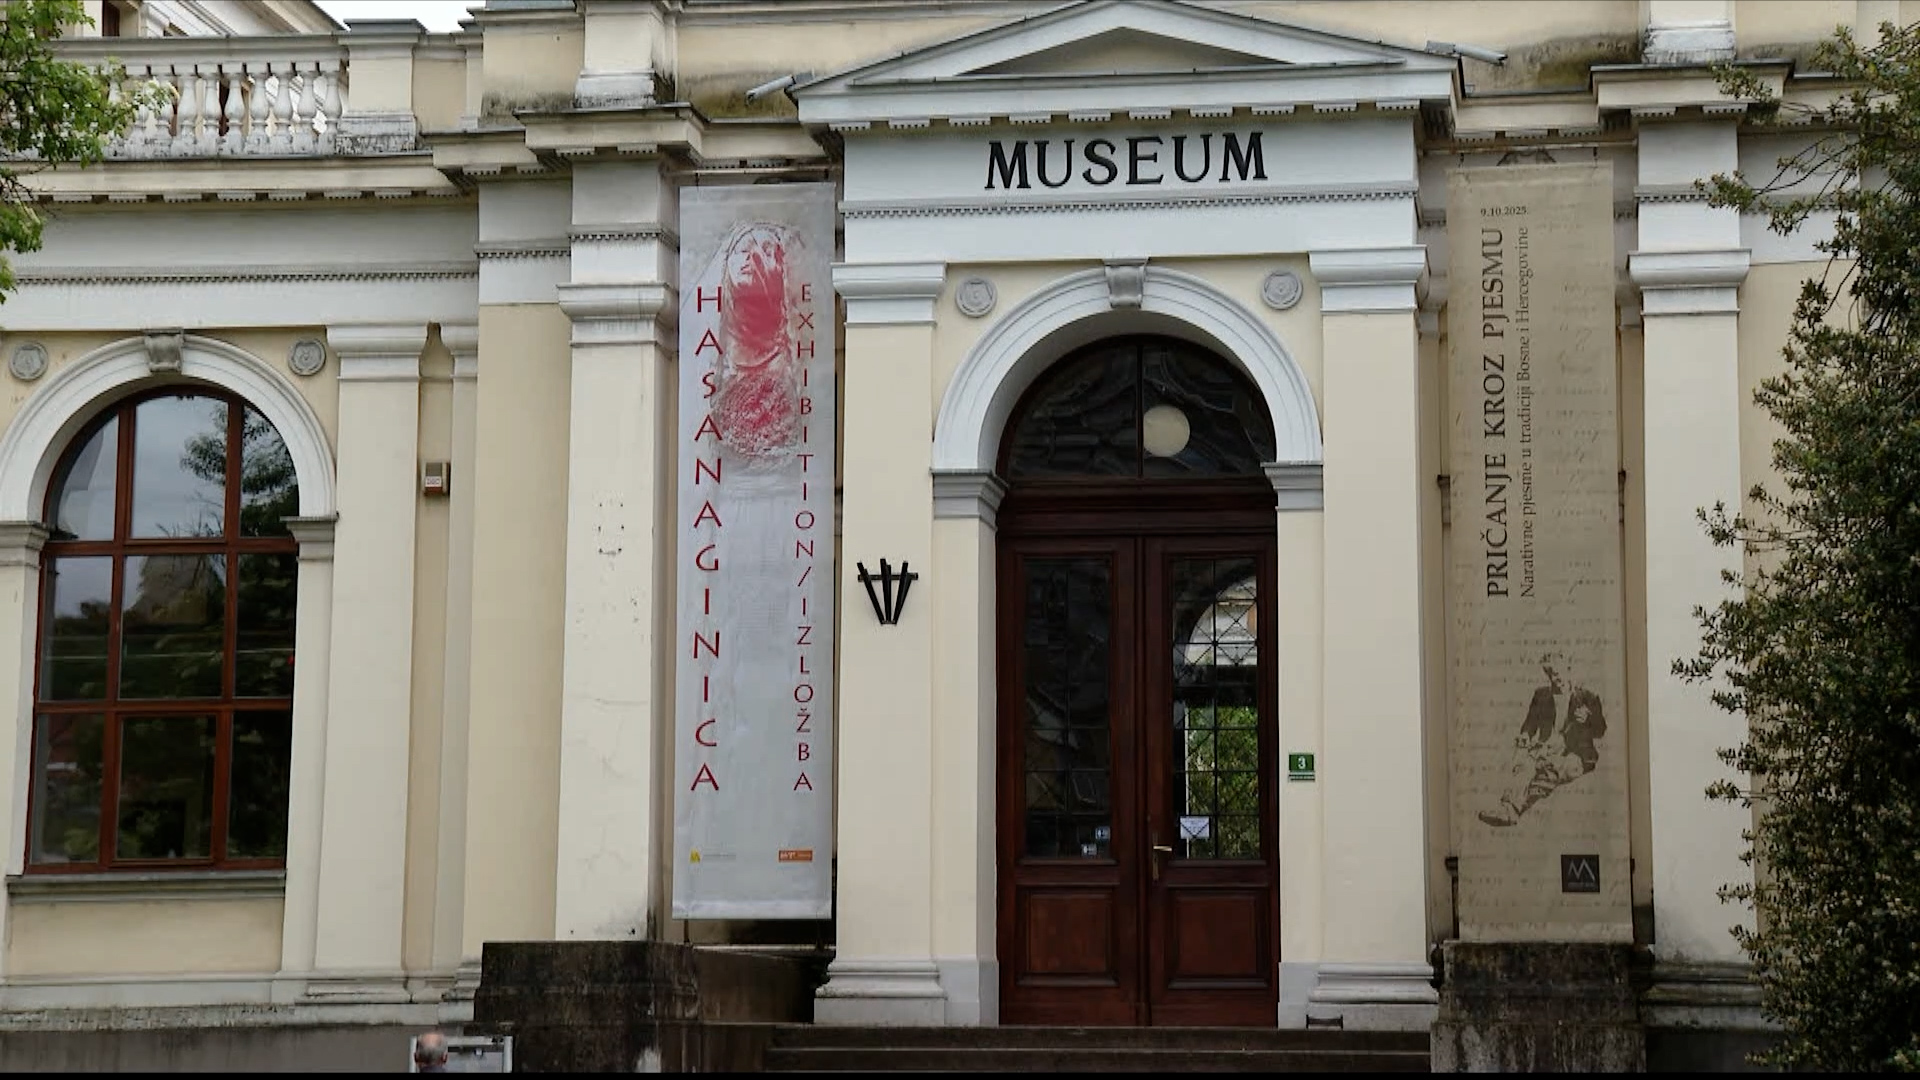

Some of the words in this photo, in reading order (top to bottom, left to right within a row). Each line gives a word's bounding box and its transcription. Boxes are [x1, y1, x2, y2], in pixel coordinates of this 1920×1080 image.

[984, 132, 1268, 189] MUSEUM
[1481, 228, 1510, 339] PJESMU
[1515, 226, 1534, 323] Hercegovine
[1516, 335, 1531, 381] Bosne
[1483, 354, 1505, 439] KROZ
[1517, 385, 1535, 443] tradiciji
[1522, 448, 1532, 458] u
[1519, 462, 1537, 516] pjesme
[691, 286, 723, 791] HASANAGINICA
[1480, 453, 1512, 598] PRIČANJE
[1520, 519, 1534, 598] Narativne
[1298, 755, 1306, 770] 3
